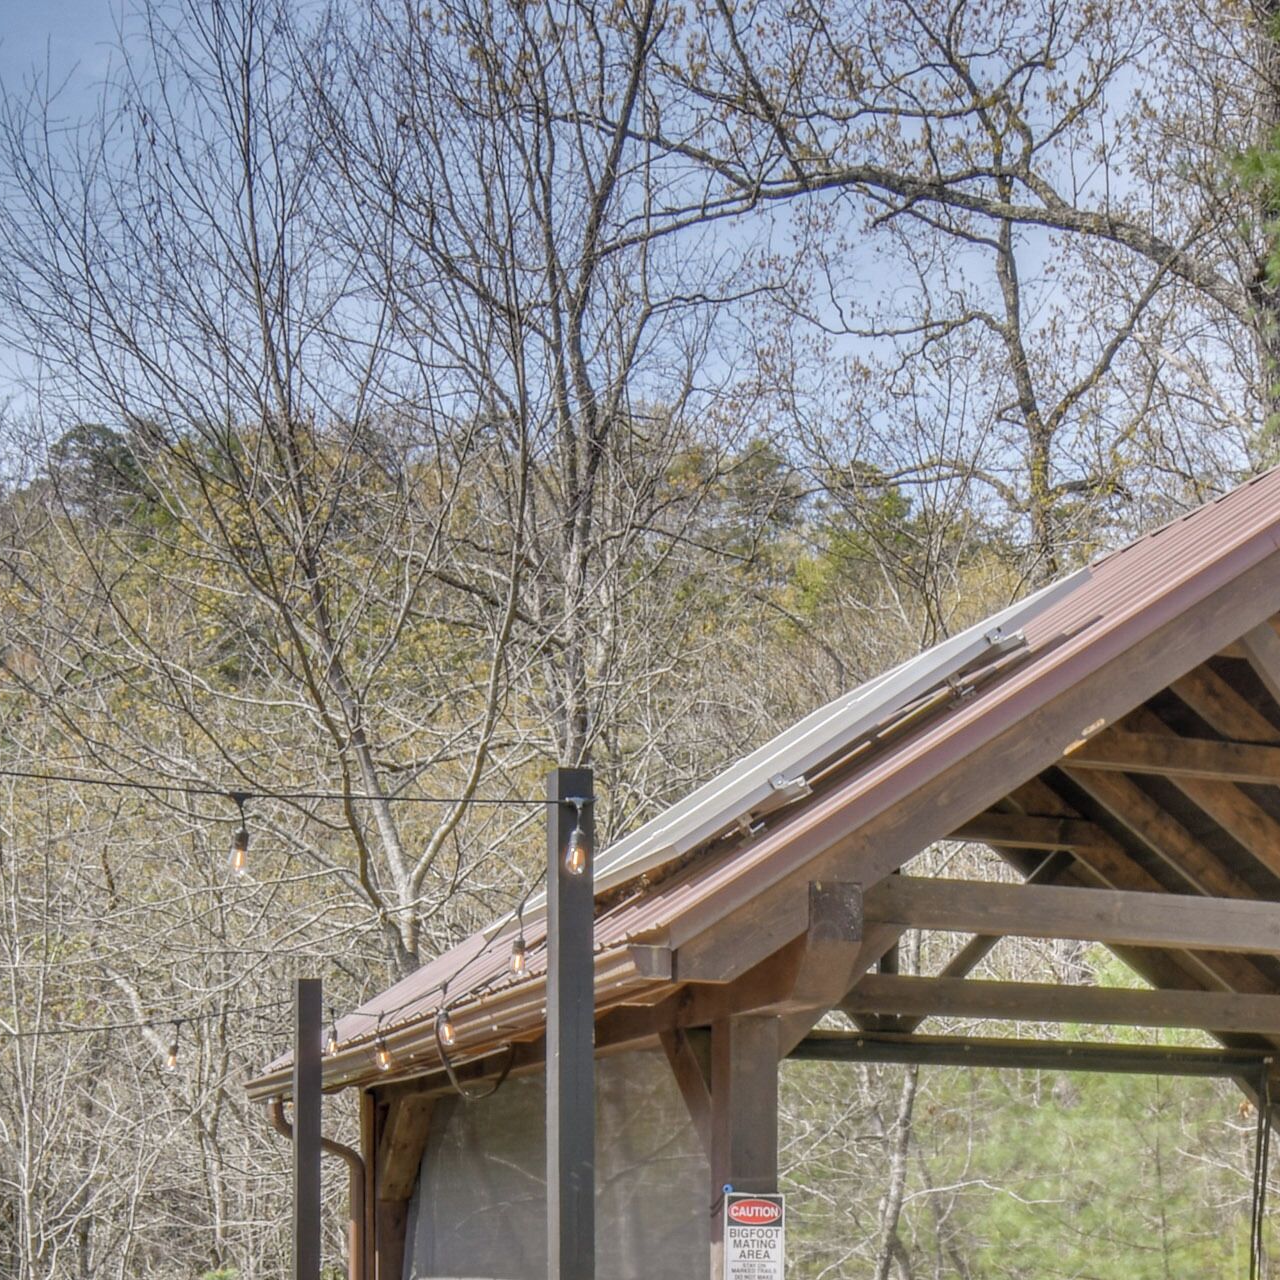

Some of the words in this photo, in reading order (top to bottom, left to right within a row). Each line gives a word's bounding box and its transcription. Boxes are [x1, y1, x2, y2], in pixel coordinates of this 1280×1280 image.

[730, 1206, 778, 1217] CAUTION
[729, 1228, 781, 1239] BIGFOOT
[733, 1239, 776, 1249] MATING
[739, 1250, 770, 1259] AREA
